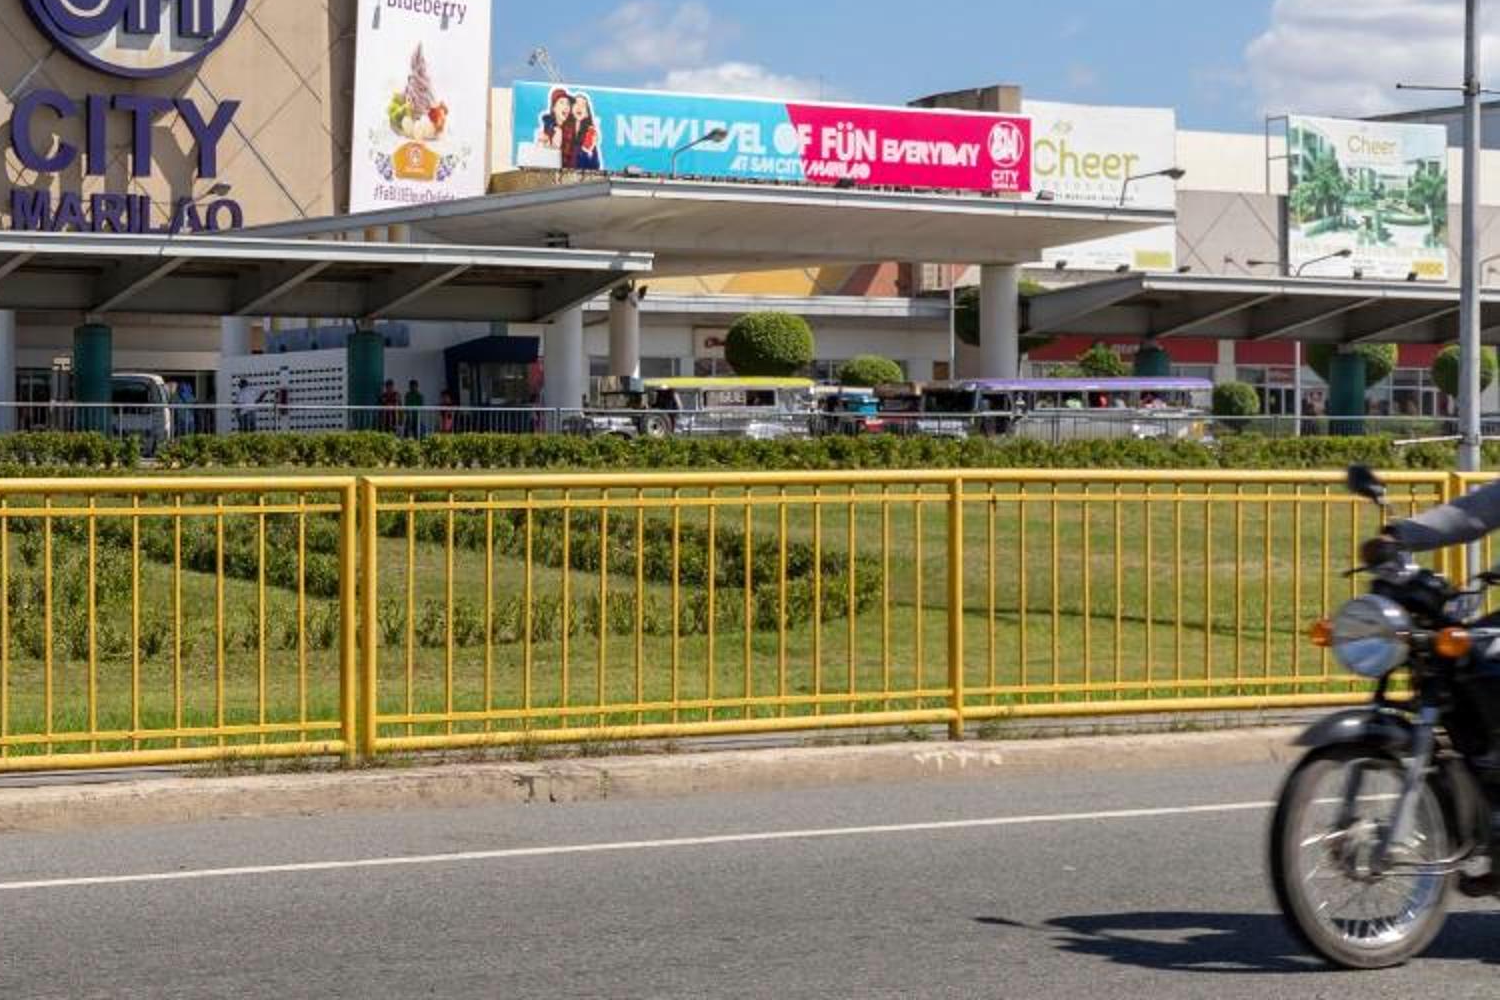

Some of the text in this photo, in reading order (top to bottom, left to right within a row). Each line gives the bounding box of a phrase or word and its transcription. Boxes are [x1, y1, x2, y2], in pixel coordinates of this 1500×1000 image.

[9, 88, 241, 179] CITY
[615, 114, 689, 149] NEW
[773, 122, 812, 155] OF
[821, 121, 877, 161] FÜN
[881, 138, 981, 167] EVERYDAY
[1348, 134, 1397, 155] Cheer
[1034, 138, 1140, 180] Cheer
[8, 189, 243, 234] MARILAO
